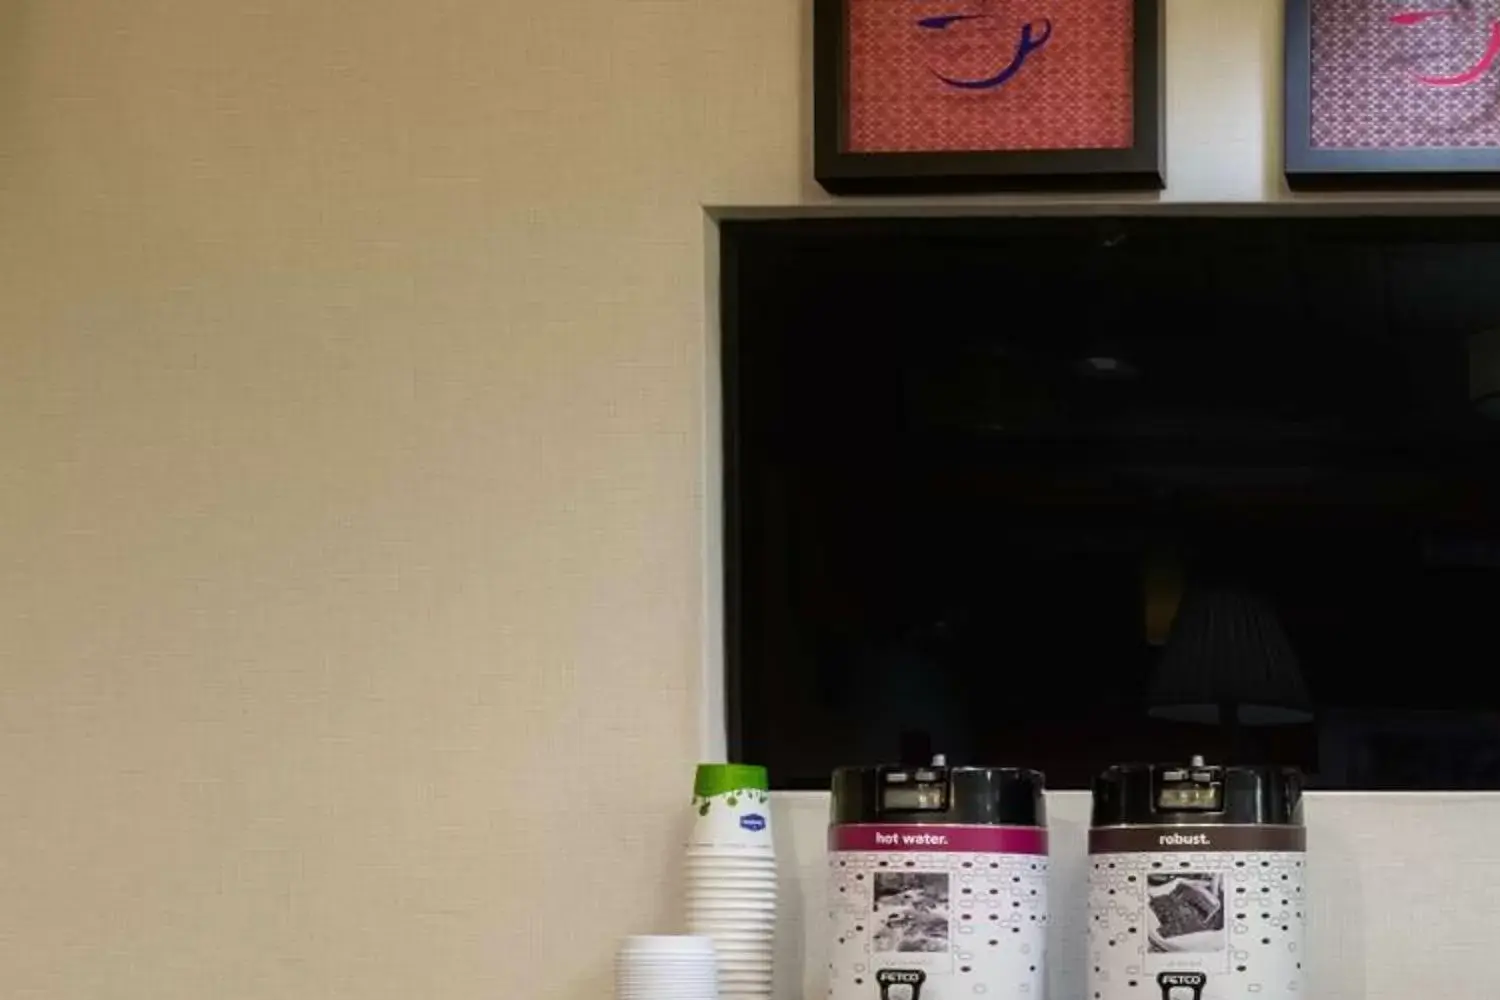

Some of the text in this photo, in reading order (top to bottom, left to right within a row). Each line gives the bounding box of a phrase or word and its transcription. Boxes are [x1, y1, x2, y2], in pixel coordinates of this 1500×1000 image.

[875, 831, 949, 845] hot water.
[1159, 832, 1211, 845] robust.
[1162, 975, 1201, 985] FETCO
